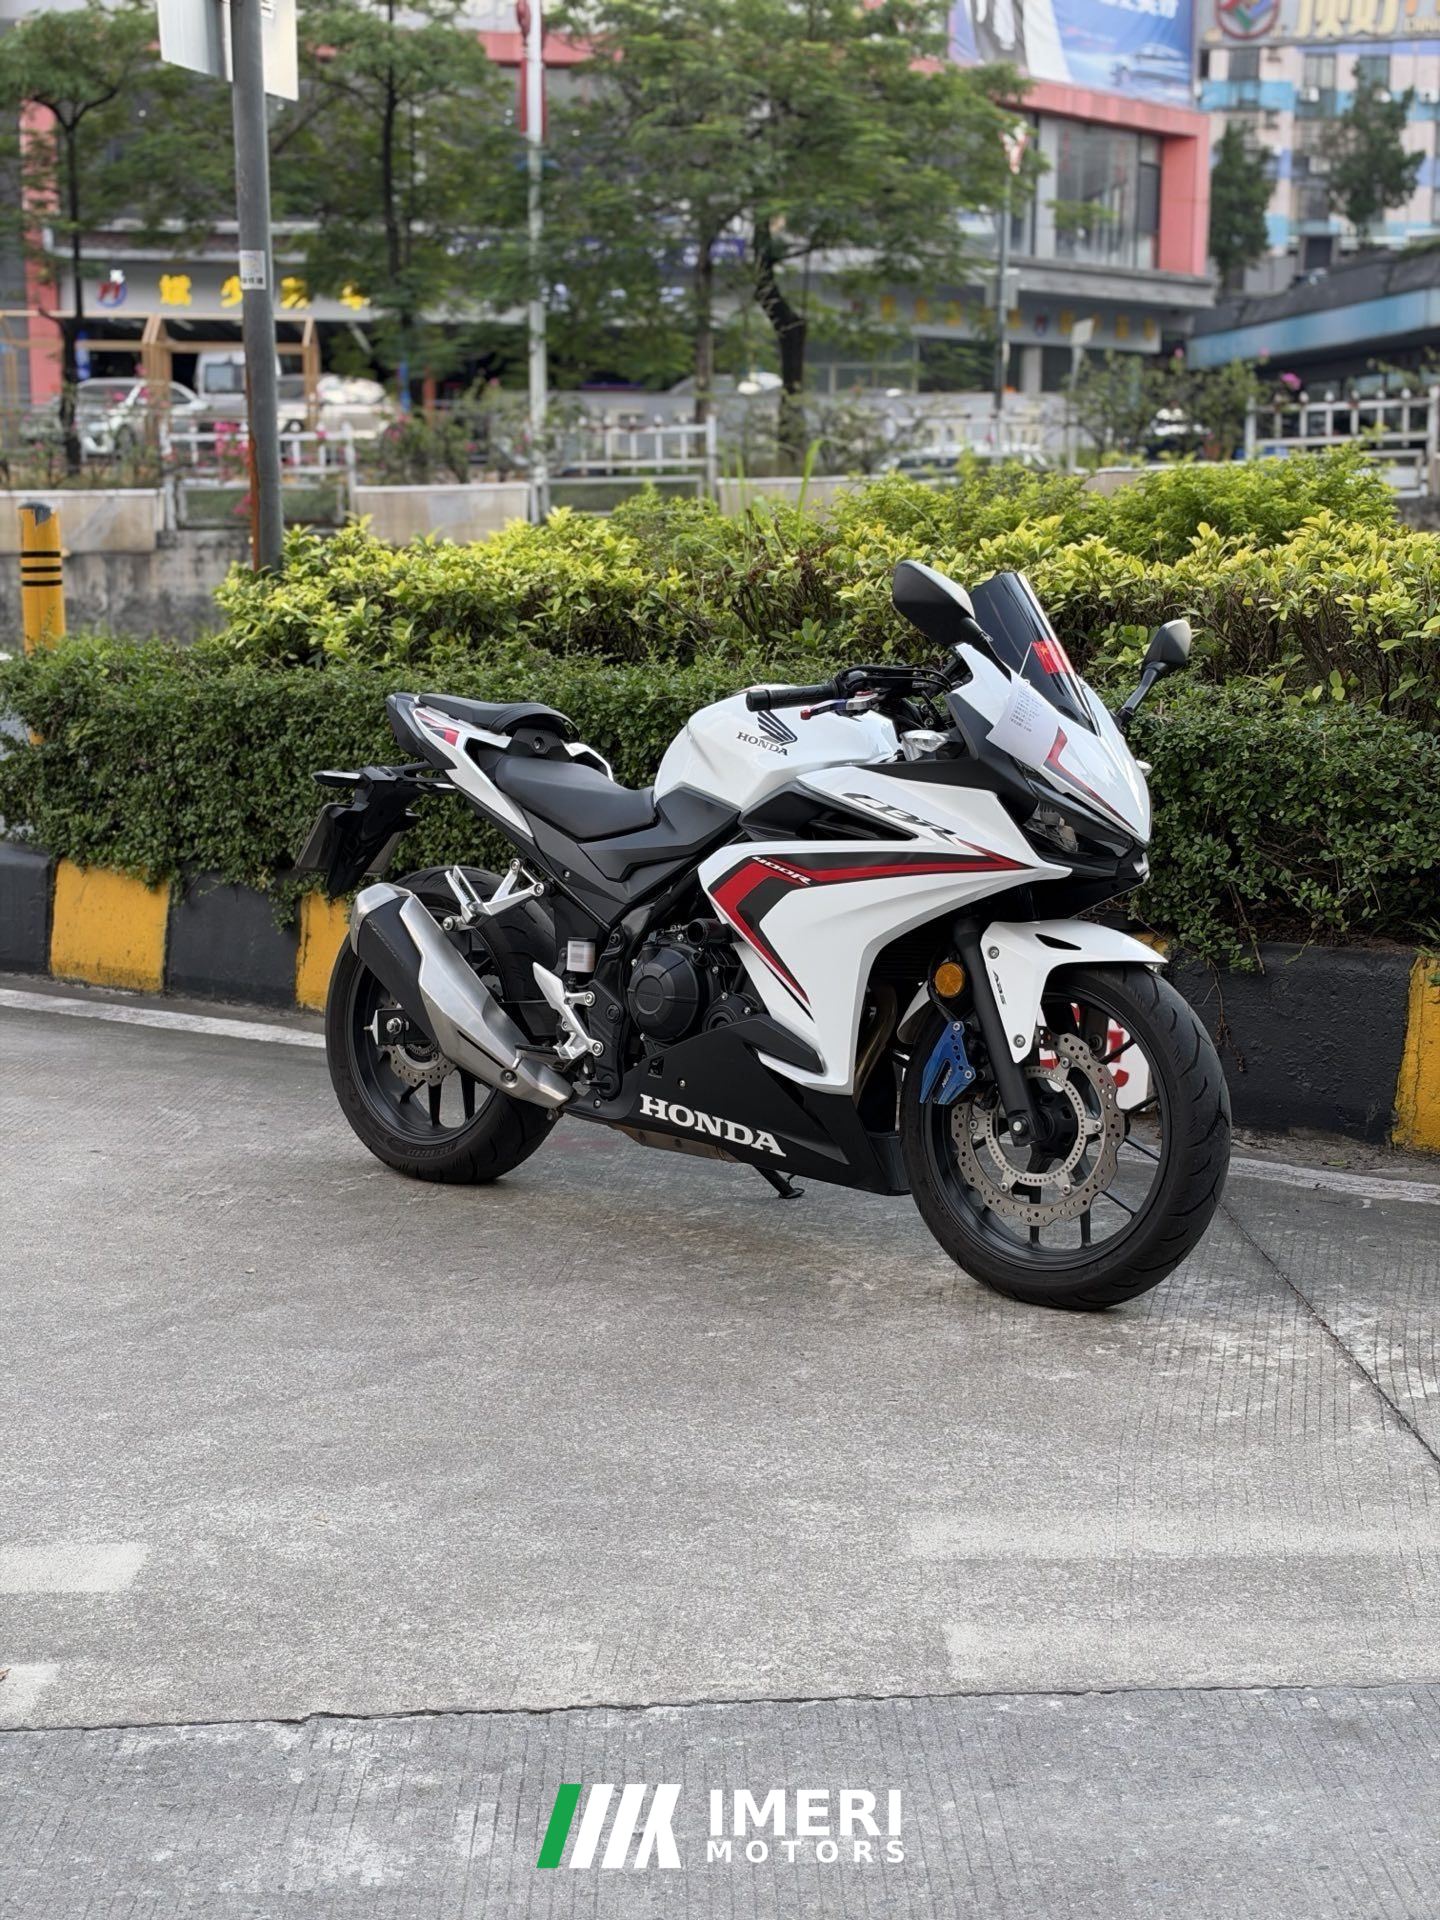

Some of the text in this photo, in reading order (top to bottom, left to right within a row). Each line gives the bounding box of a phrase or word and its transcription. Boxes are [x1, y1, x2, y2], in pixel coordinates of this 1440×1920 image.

[736, 731, 788, 756] HONDA
[841, 792, 957, 846] CBR
[751, 856, 812, 886] 400R
[992, 969, 1007, 1005] ABS
[639, 1093, 787, 1158] HONDA
